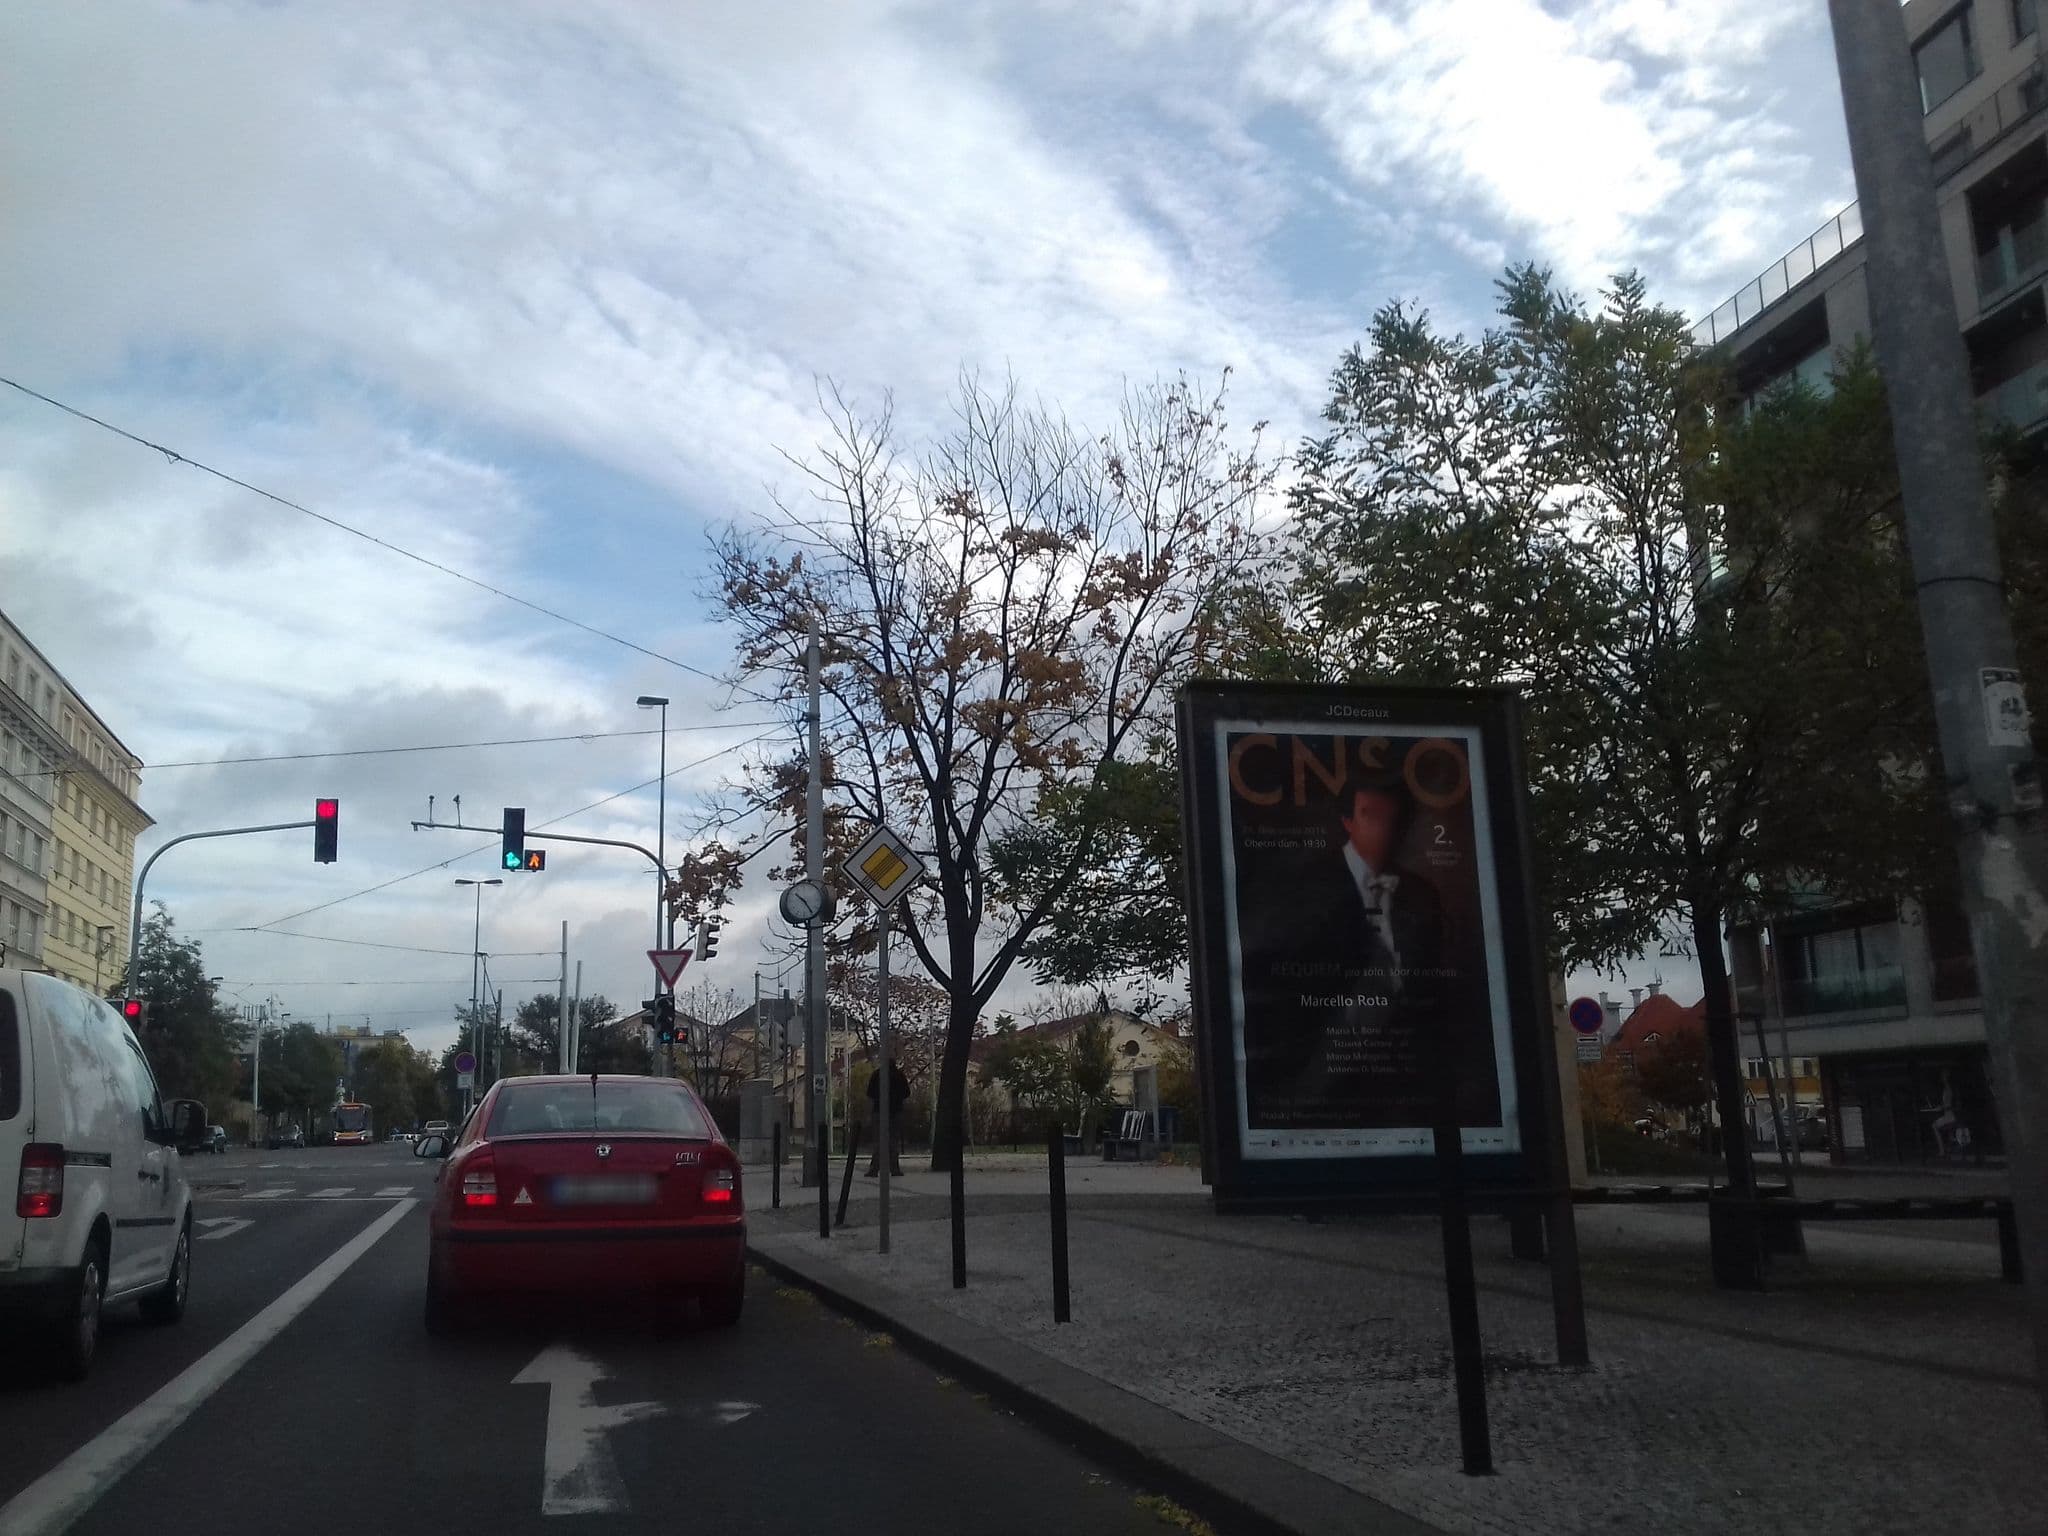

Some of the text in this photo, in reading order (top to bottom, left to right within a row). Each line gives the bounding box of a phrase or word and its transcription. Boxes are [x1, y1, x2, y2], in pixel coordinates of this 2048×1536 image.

[1325, 704, 1390, 719] JCDecaux
[1433, 824, 1453, 845] 2.
[1299, 993, 1353, 1008] Marcello
[1357, 993, 1389, 1007] Rota
